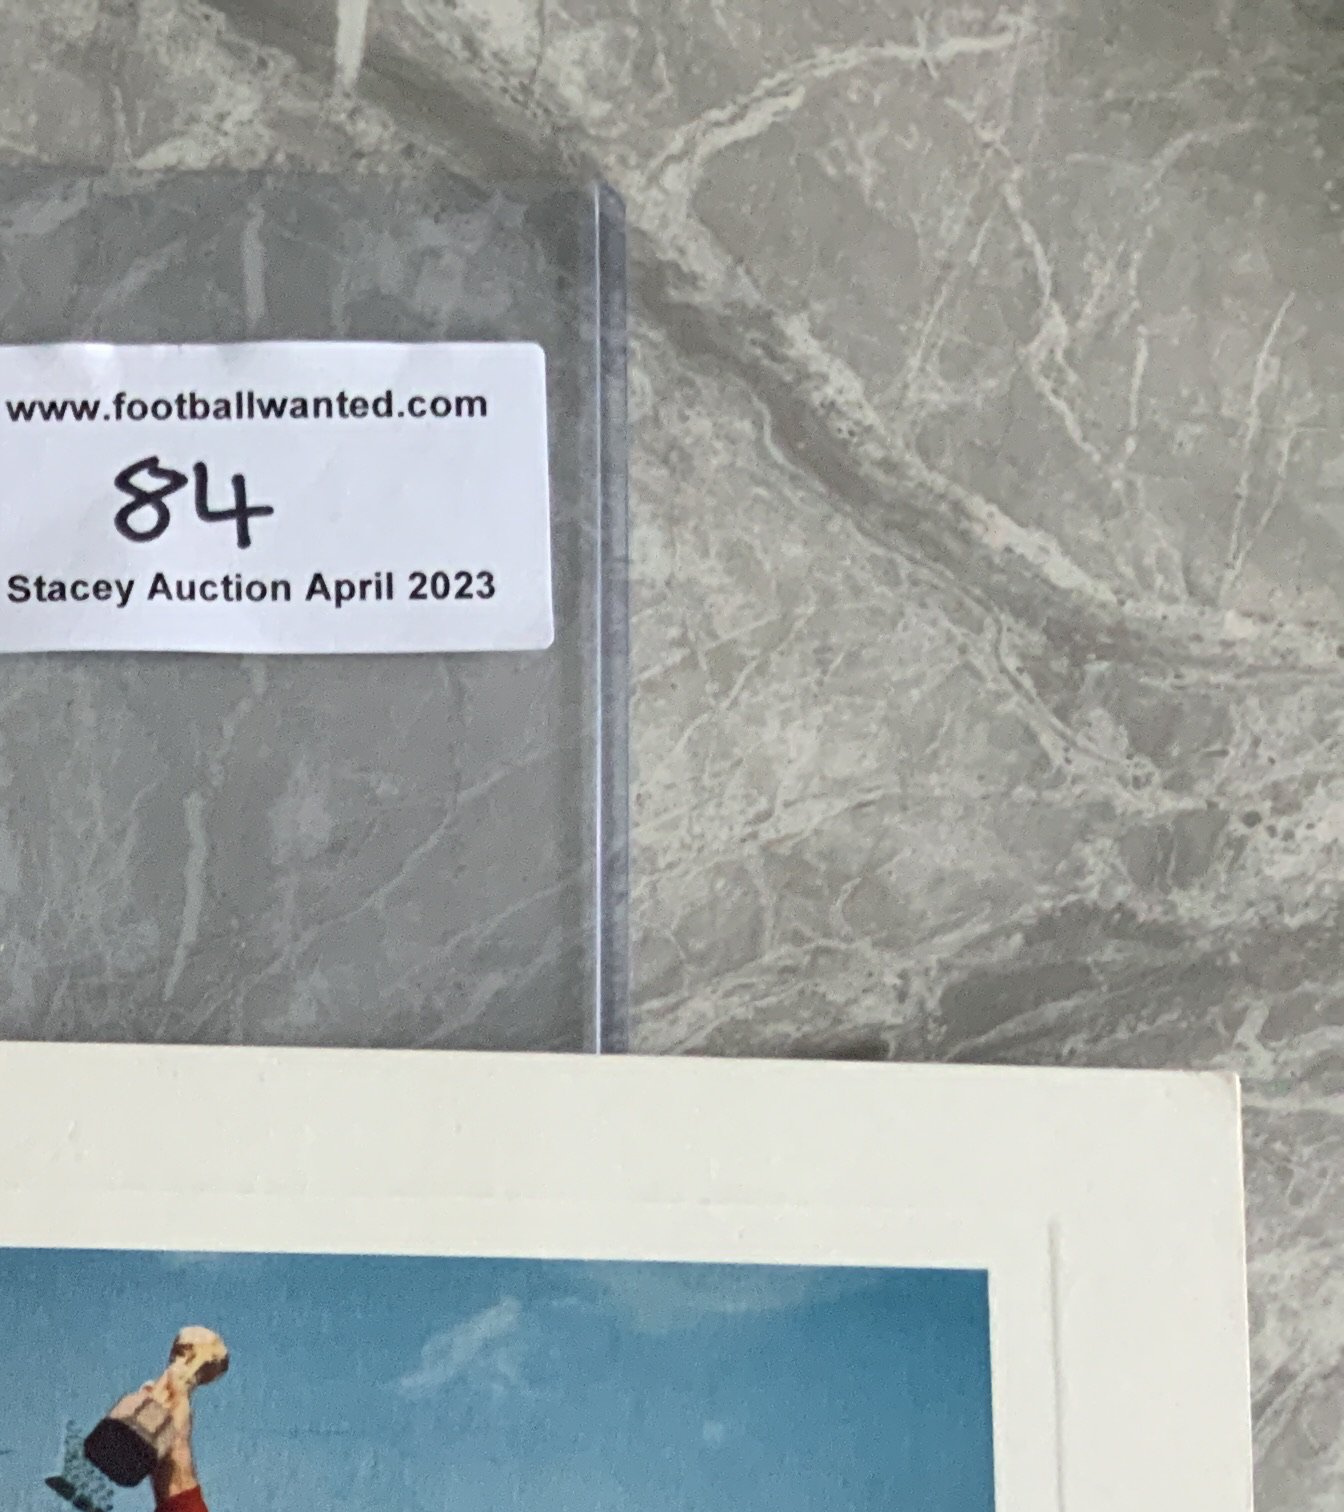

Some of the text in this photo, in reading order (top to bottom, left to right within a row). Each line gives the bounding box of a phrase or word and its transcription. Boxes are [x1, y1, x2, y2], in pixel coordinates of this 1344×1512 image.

[5, 389, 488, 423] www.footballwanted.com
[113, 455, 275, 550] 84
[6, 570, 496, 609] Stacey Auction April 2023
